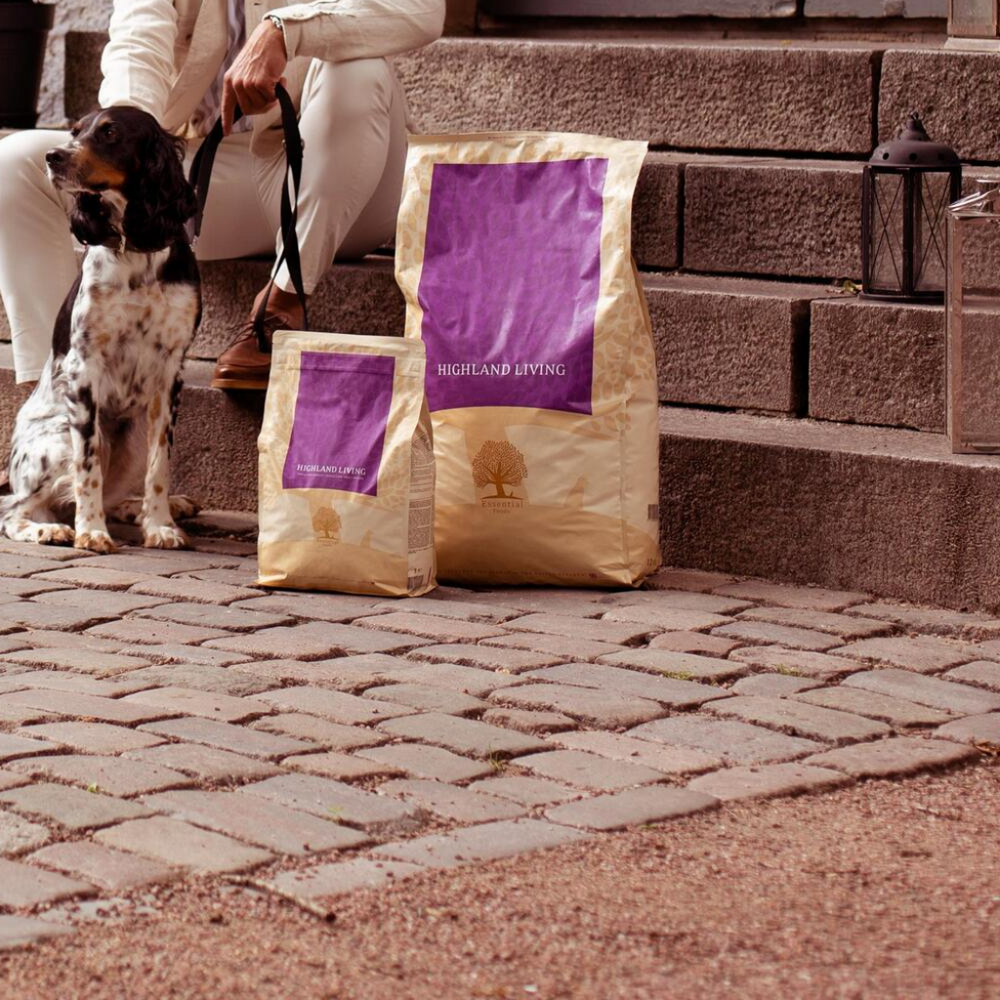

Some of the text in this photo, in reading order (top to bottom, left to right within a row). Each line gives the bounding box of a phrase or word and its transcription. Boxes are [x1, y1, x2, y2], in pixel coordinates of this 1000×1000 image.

[437, 363, 566, 376] HIGHLAND LIVING
[296, 463, 338, 473] HIGHLAND
[338, 466, 366, 476] LIVING
[481, 500, 524, 509] Essential
